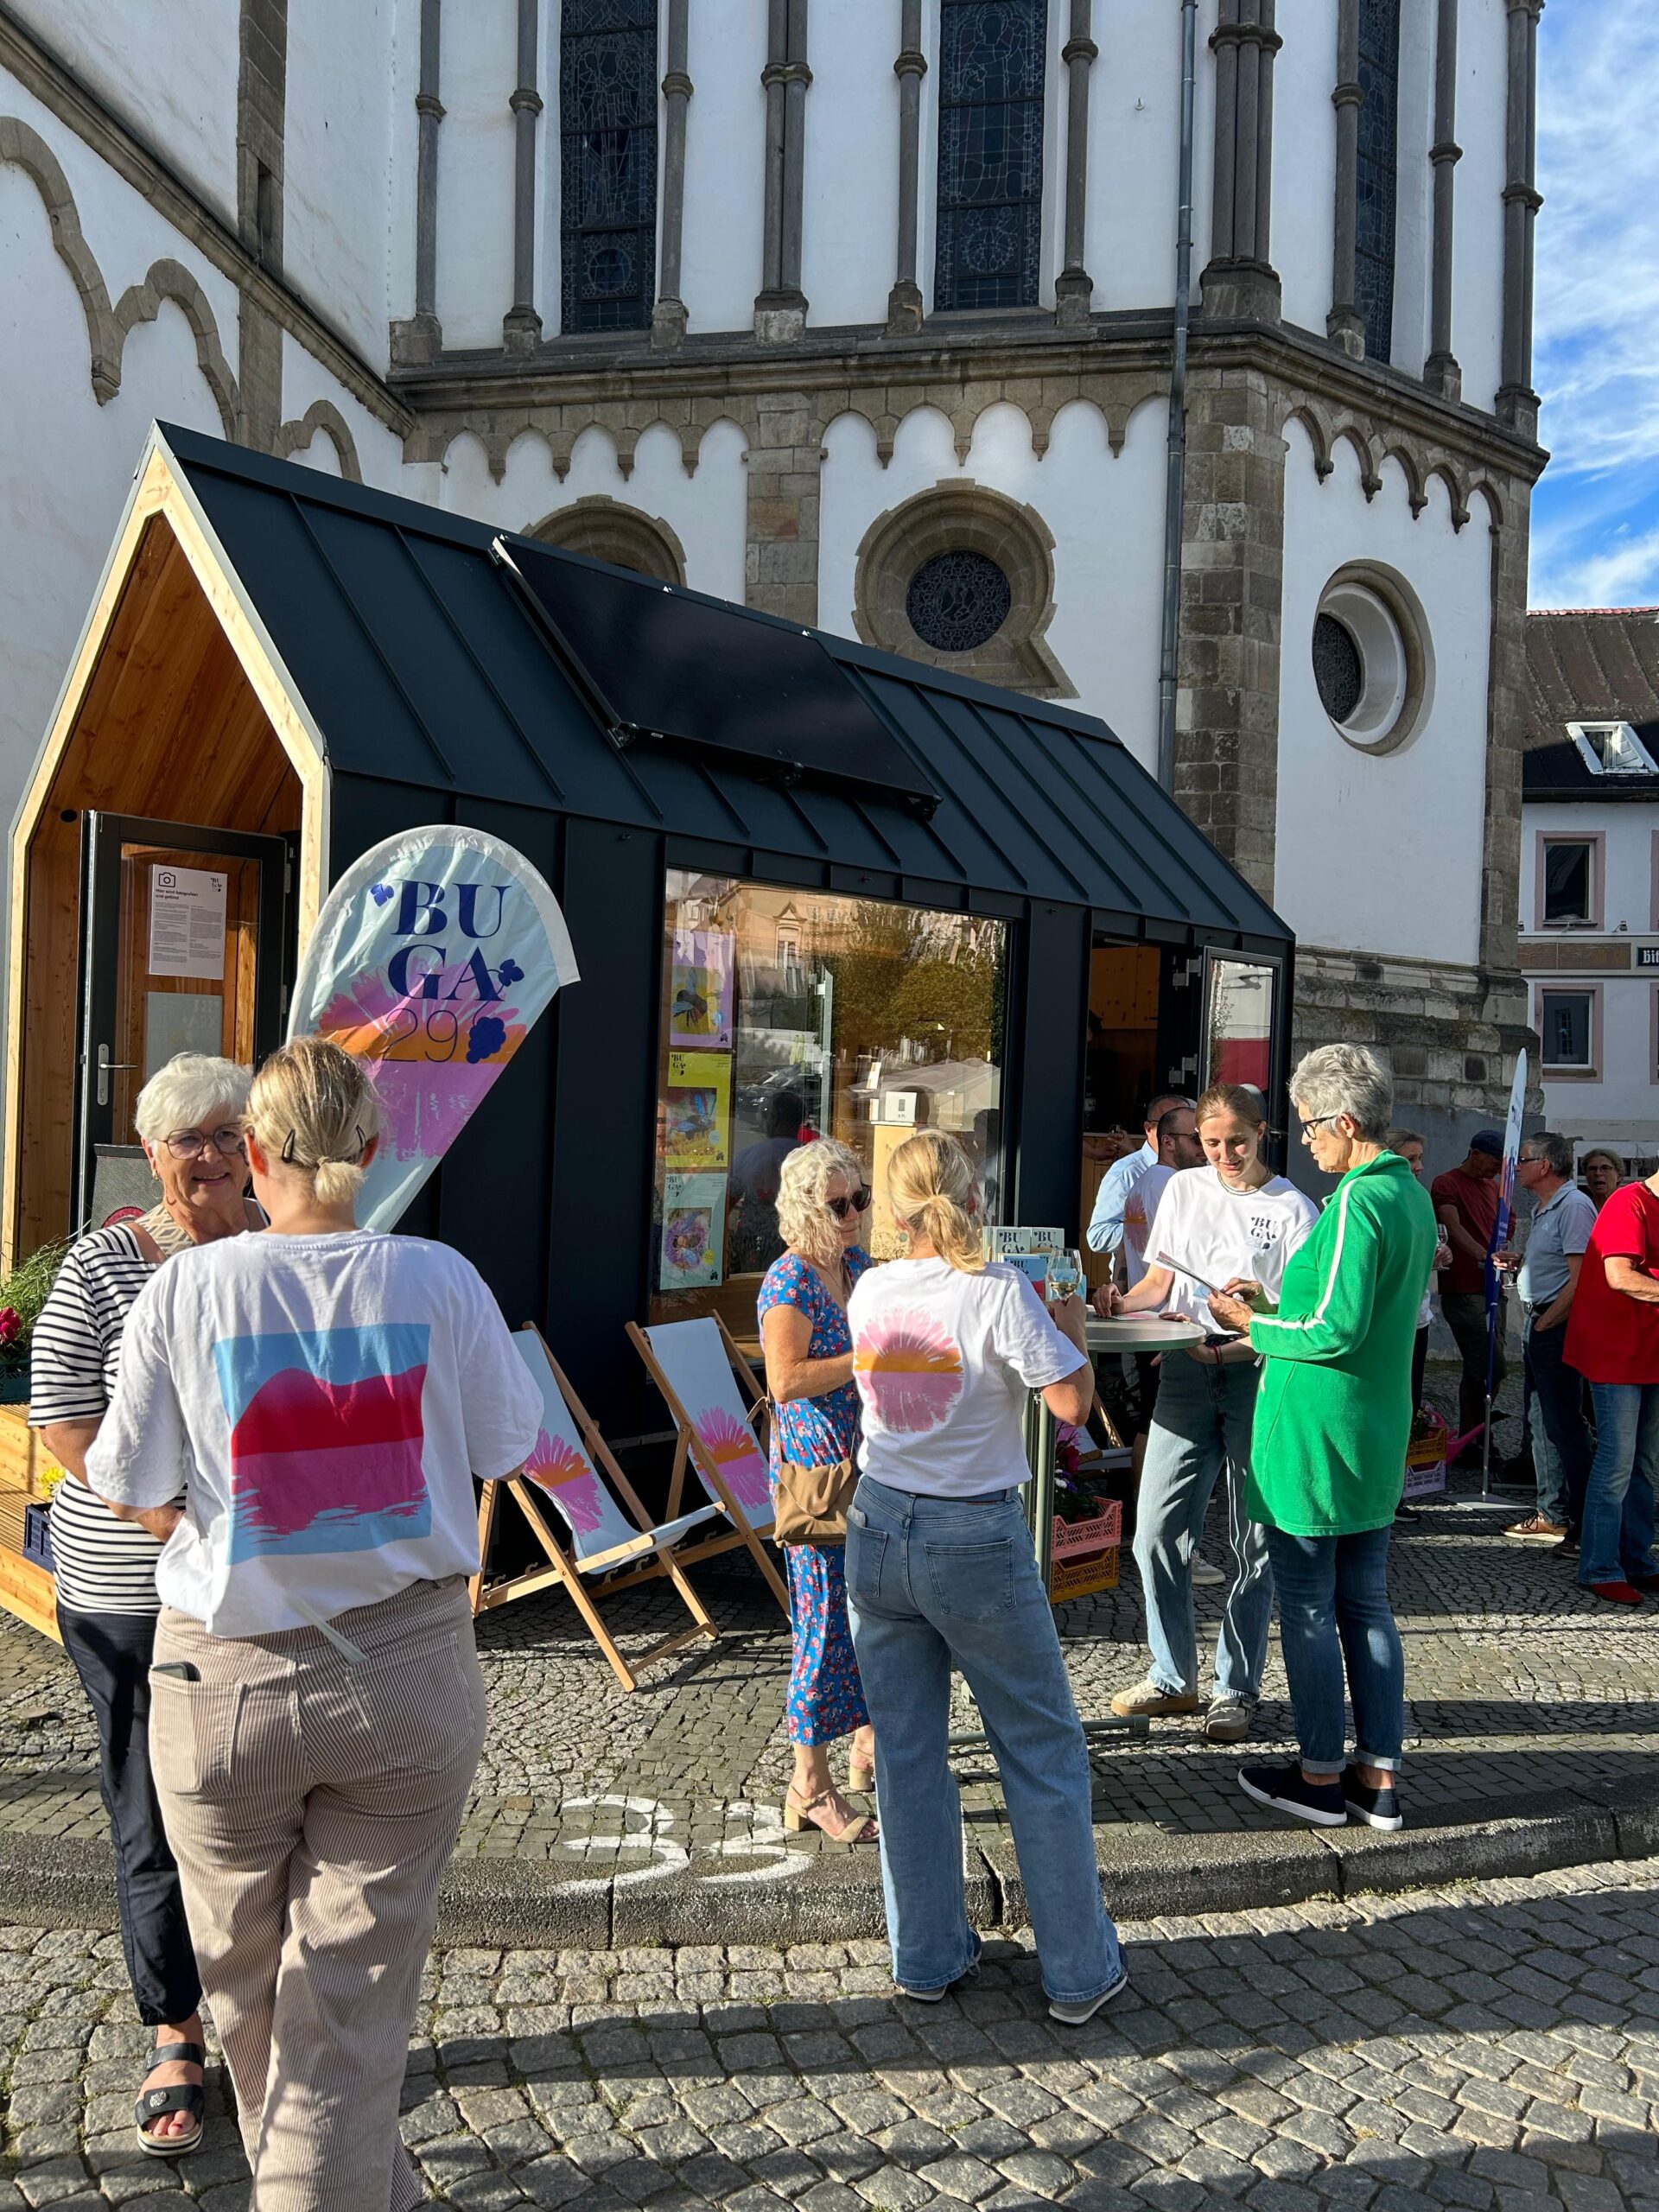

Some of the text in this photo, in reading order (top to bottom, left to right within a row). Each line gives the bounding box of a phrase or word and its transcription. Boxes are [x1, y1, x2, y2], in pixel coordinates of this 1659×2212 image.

[391, 879, 513, 939] BU
[388, 944, 505, 1001] GA
[382, 1007, 459, 1063] 29
[1254, 1217, 1278, 1230] BU
[1003, 1231, 1022, 1243] BU
[1038, 1230, 1057, 1243] BU
[1250, 1227, 1272, 1241] GA
[1002, 1243, 1020, 1254] GA
